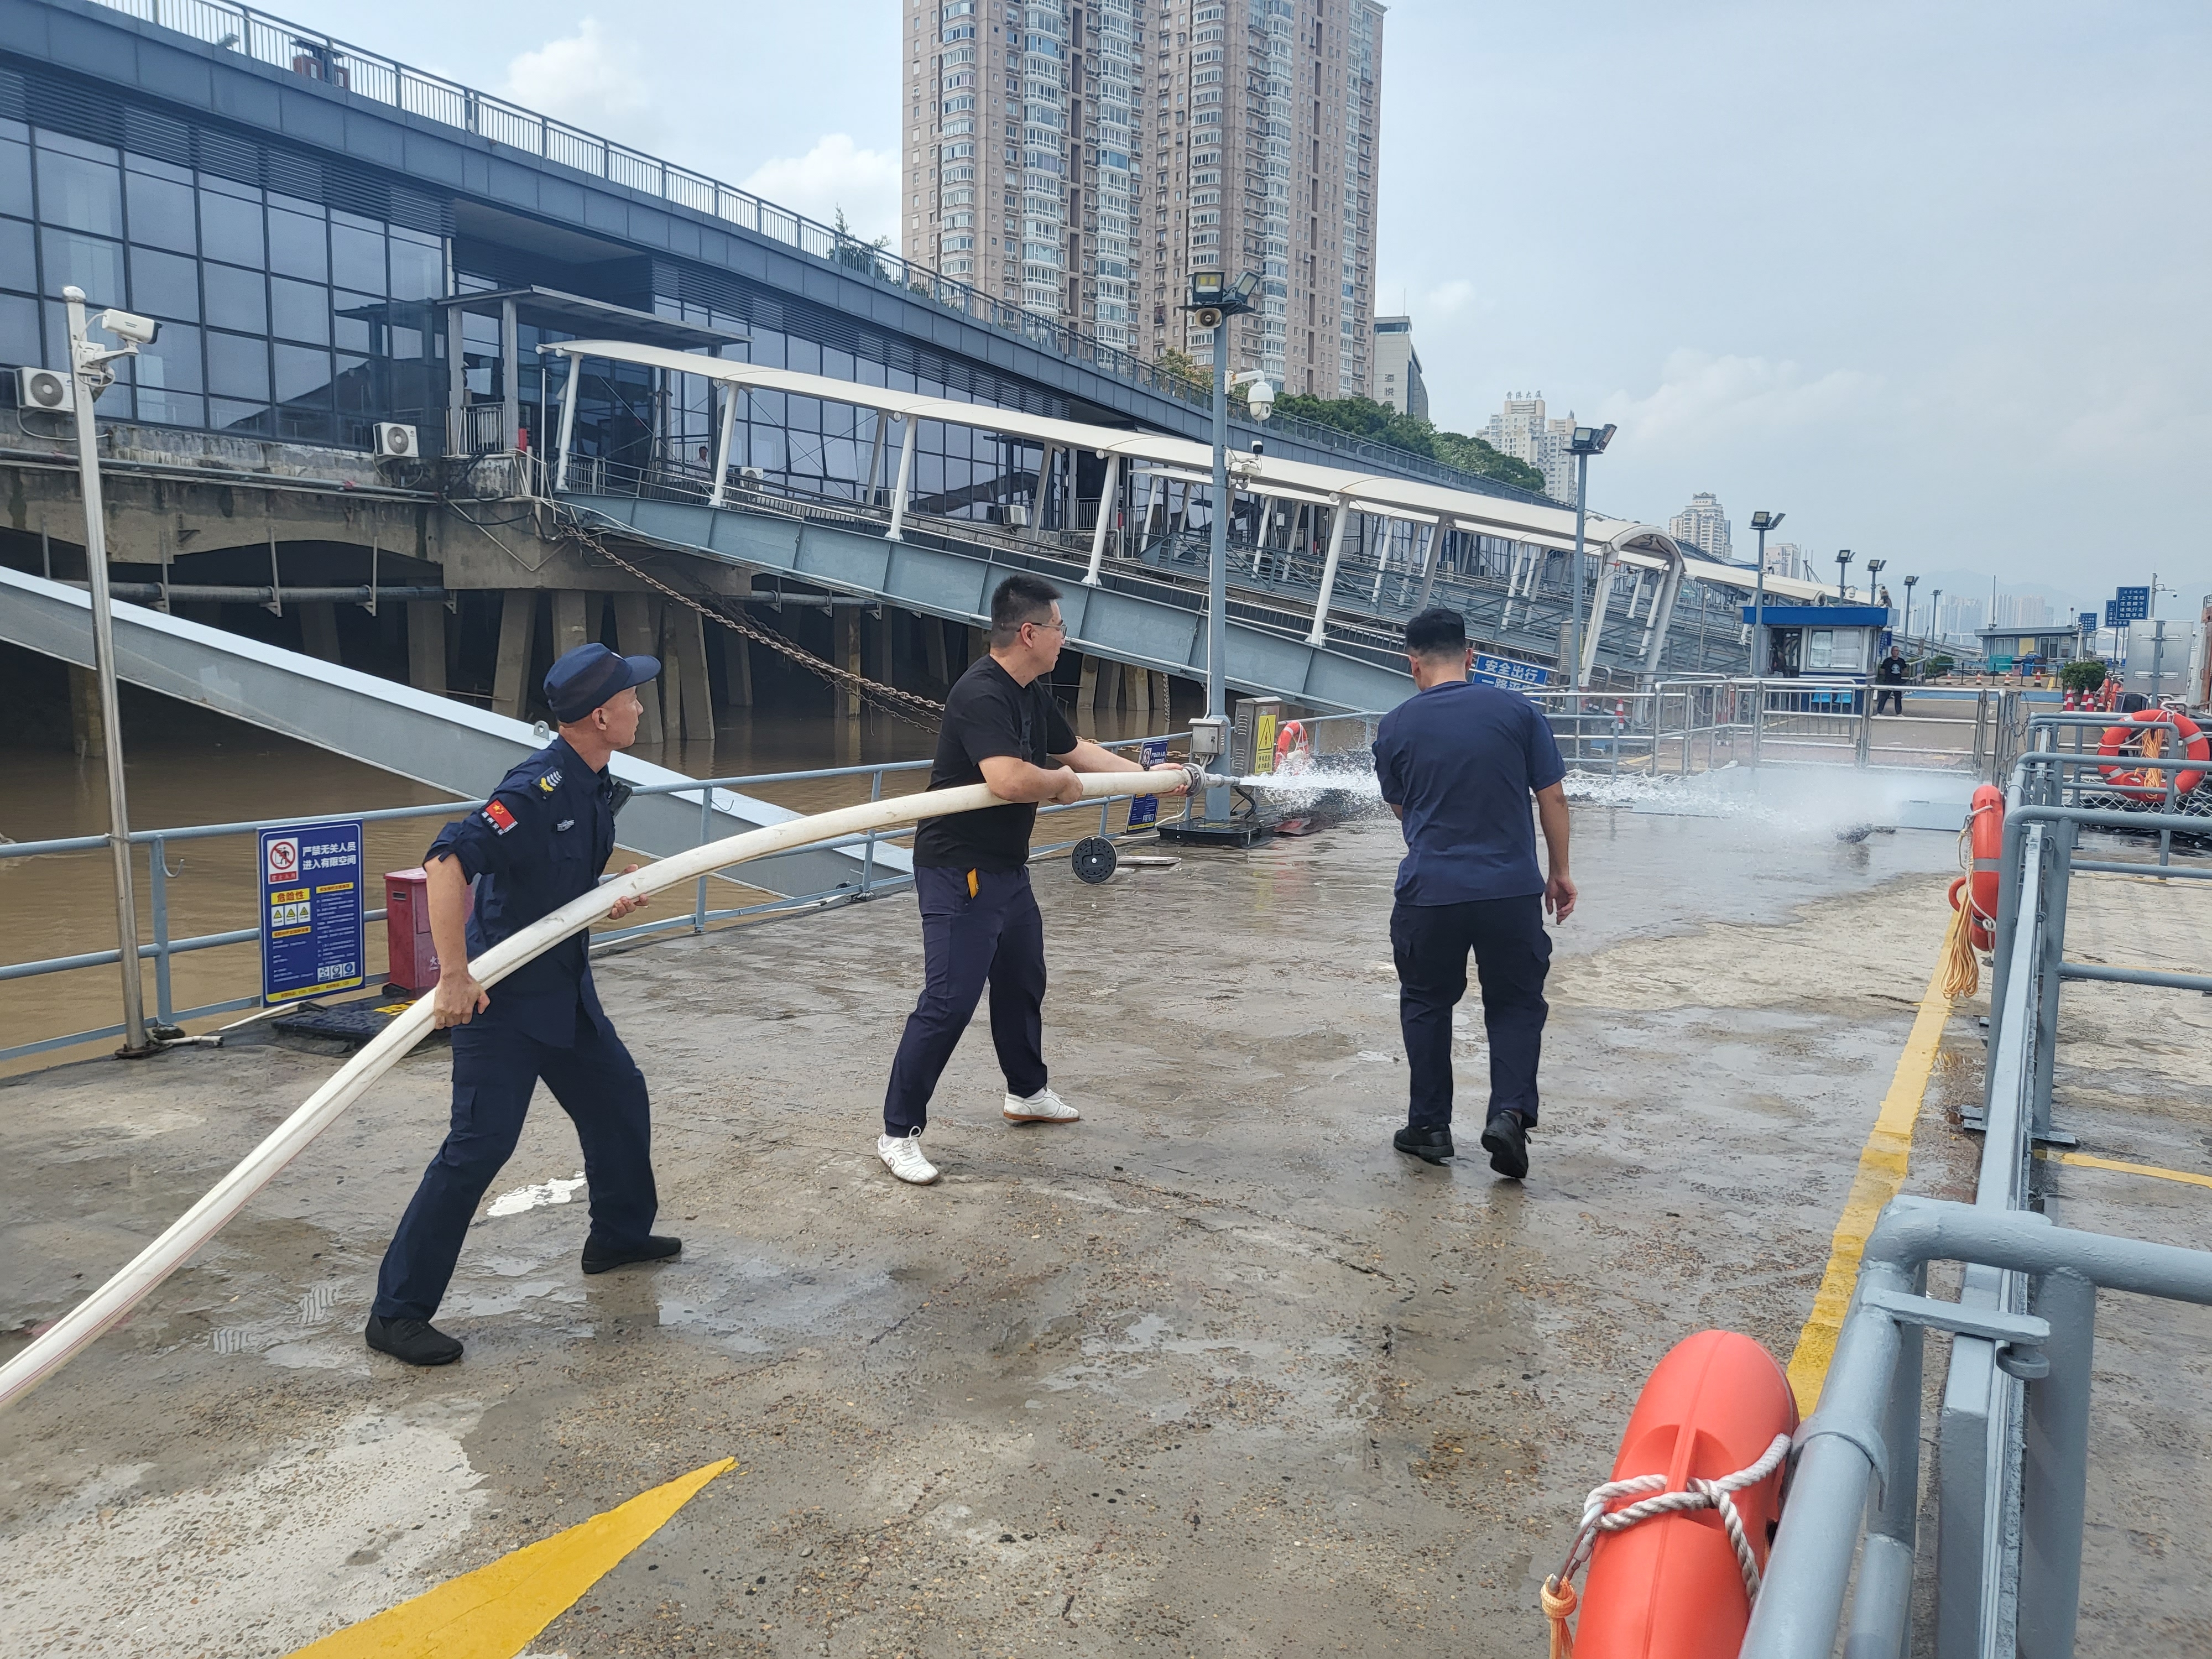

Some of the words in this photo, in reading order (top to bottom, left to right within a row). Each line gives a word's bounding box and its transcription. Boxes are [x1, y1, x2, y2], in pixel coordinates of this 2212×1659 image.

[1484, 659, 1538, 682] 安全出行
[302, 841, 357, 857] 严禁无关人员
[302, 854, 357, 871] 进入有限空间
[277, 890, 305, 902] 危险性
